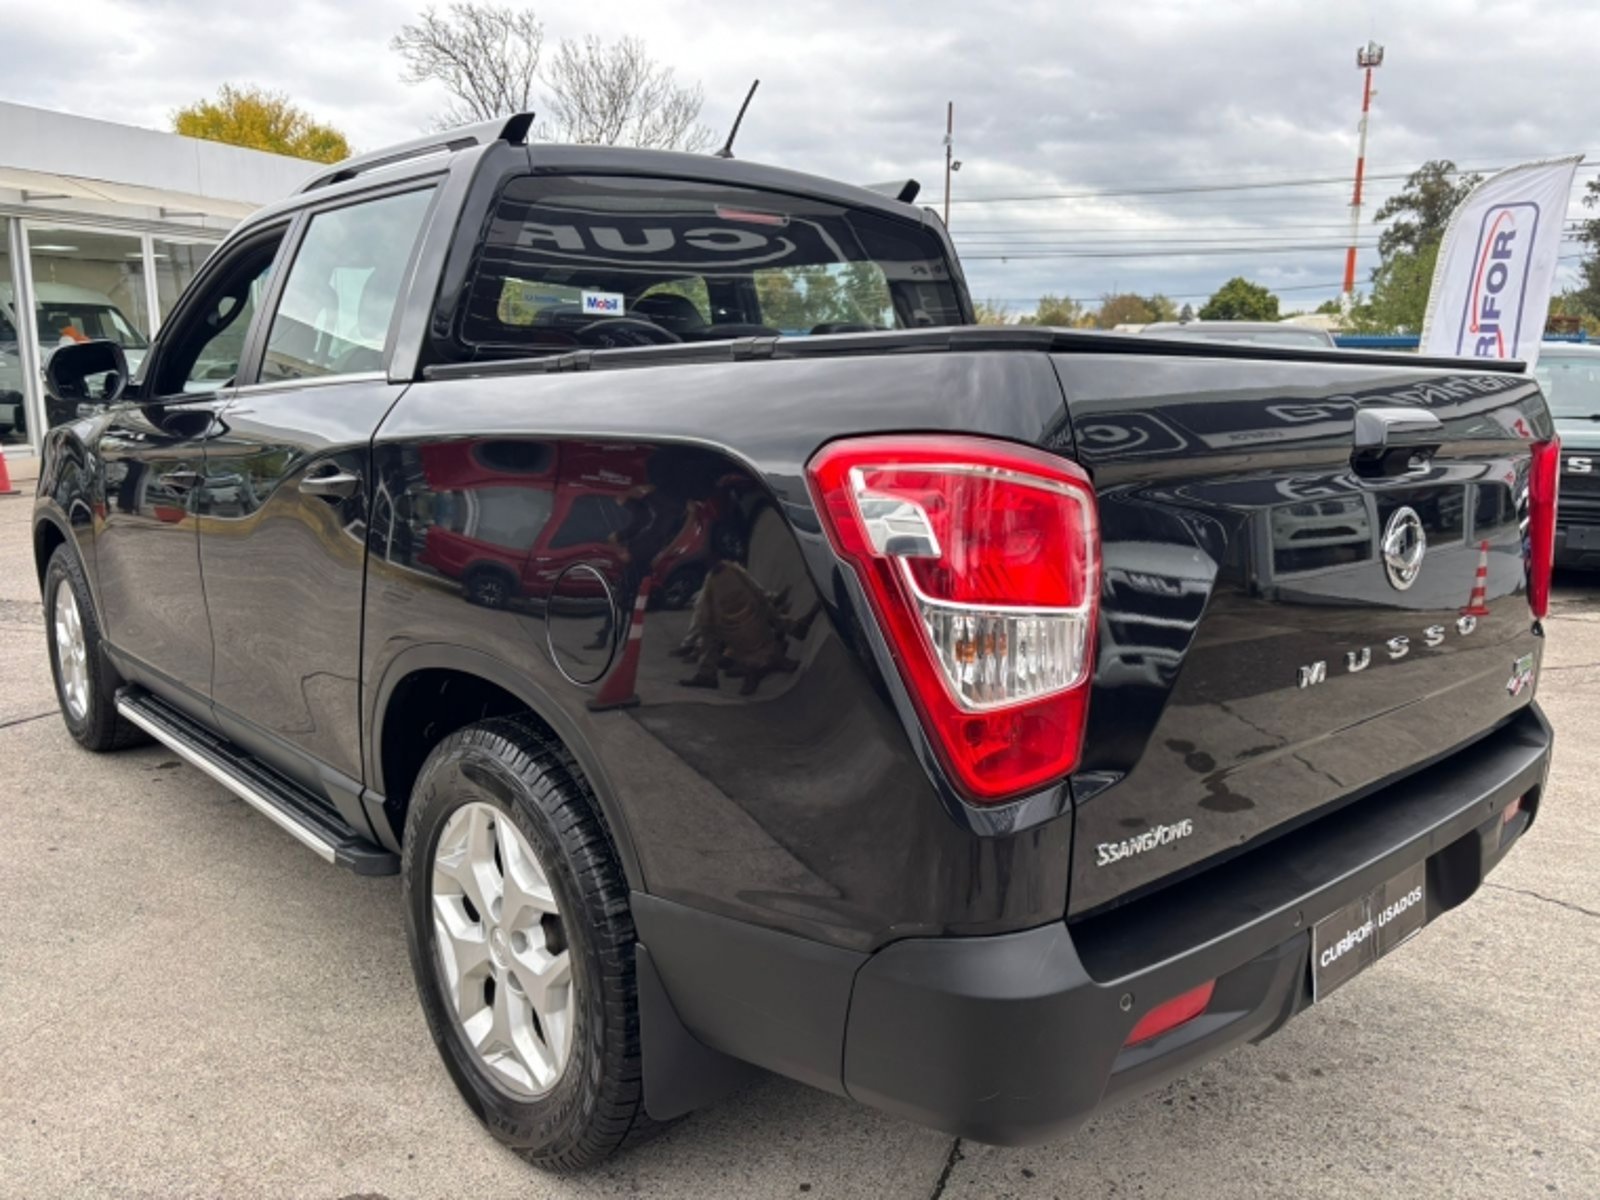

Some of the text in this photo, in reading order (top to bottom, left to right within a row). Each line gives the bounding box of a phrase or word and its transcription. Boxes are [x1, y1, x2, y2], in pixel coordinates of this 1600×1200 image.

[586, 296, 618, 310] Mobil
[1567, 456, 1592, 473] S
[1297, 614, 1478, 690] MUSSO
[1377, 885, 1422, 927] USADOS
